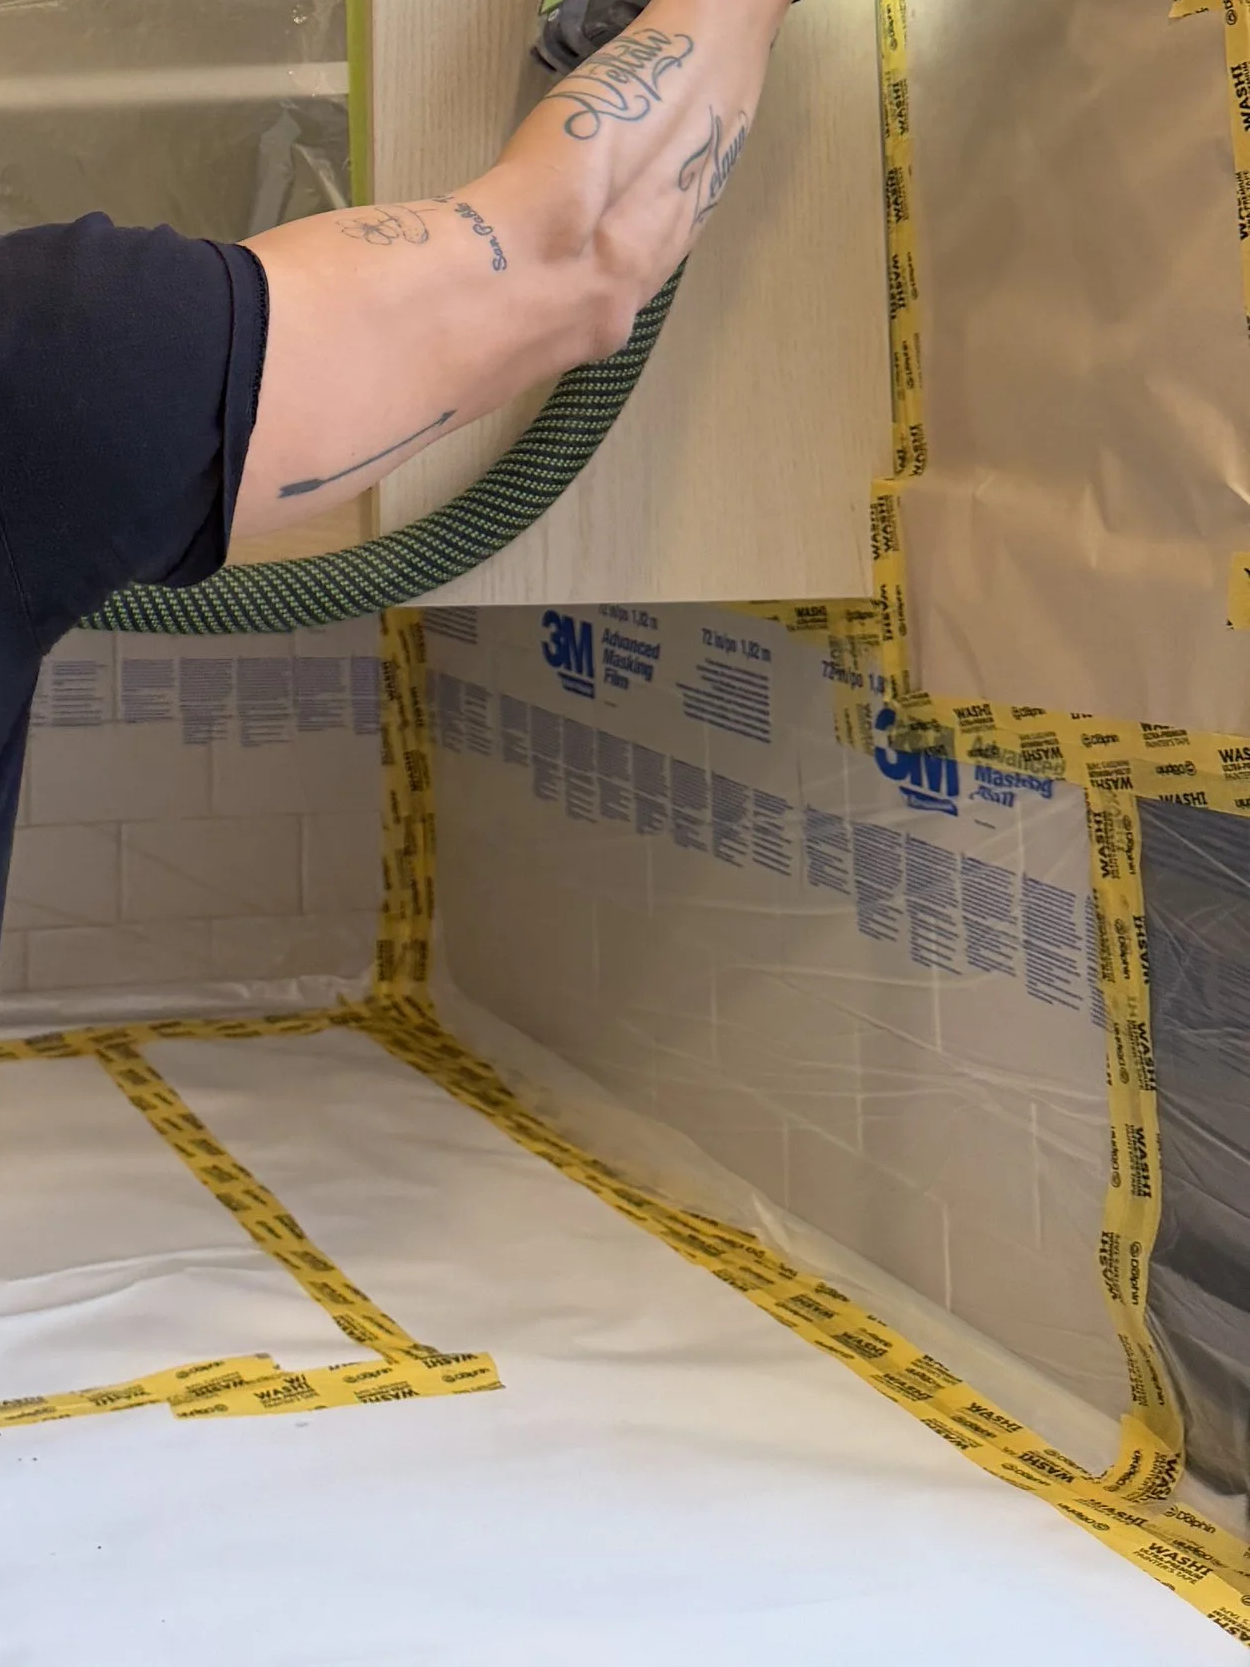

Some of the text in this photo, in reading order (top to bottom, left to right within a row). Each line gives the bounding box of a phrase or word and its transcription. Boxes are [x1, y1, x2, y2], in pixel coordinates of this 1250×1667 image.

[541, 610, 595, 679] 3M
[602, 628, 661, 661] Advanced
[701, 628, 716, 645] 72
[602, 649, 654, 682] Masking
[603, 670, 630, 690] Film
[874, 707, 960, 797] 3M
[1092, 811, 1110, 878] WASHI
[1135, 1127, 1152, 1198] WASHI
[1130, 1258, 1139, 1305] Dolphin
[254, 1382, 309, 1401] WASHI
[965, 1402, 1024, 1433] WASHI
[1018, 1452, 1075, 1483] WASHI
[1176, 1510, 1216, 1534] Dolphin
[1134, 1551, 1199, 1585] PAINTER'S TAPE
[1140, 1547, 1203, 1580] ULTRA-PREMIUM
[1149, 1542, 1214, 1575] WASHI
